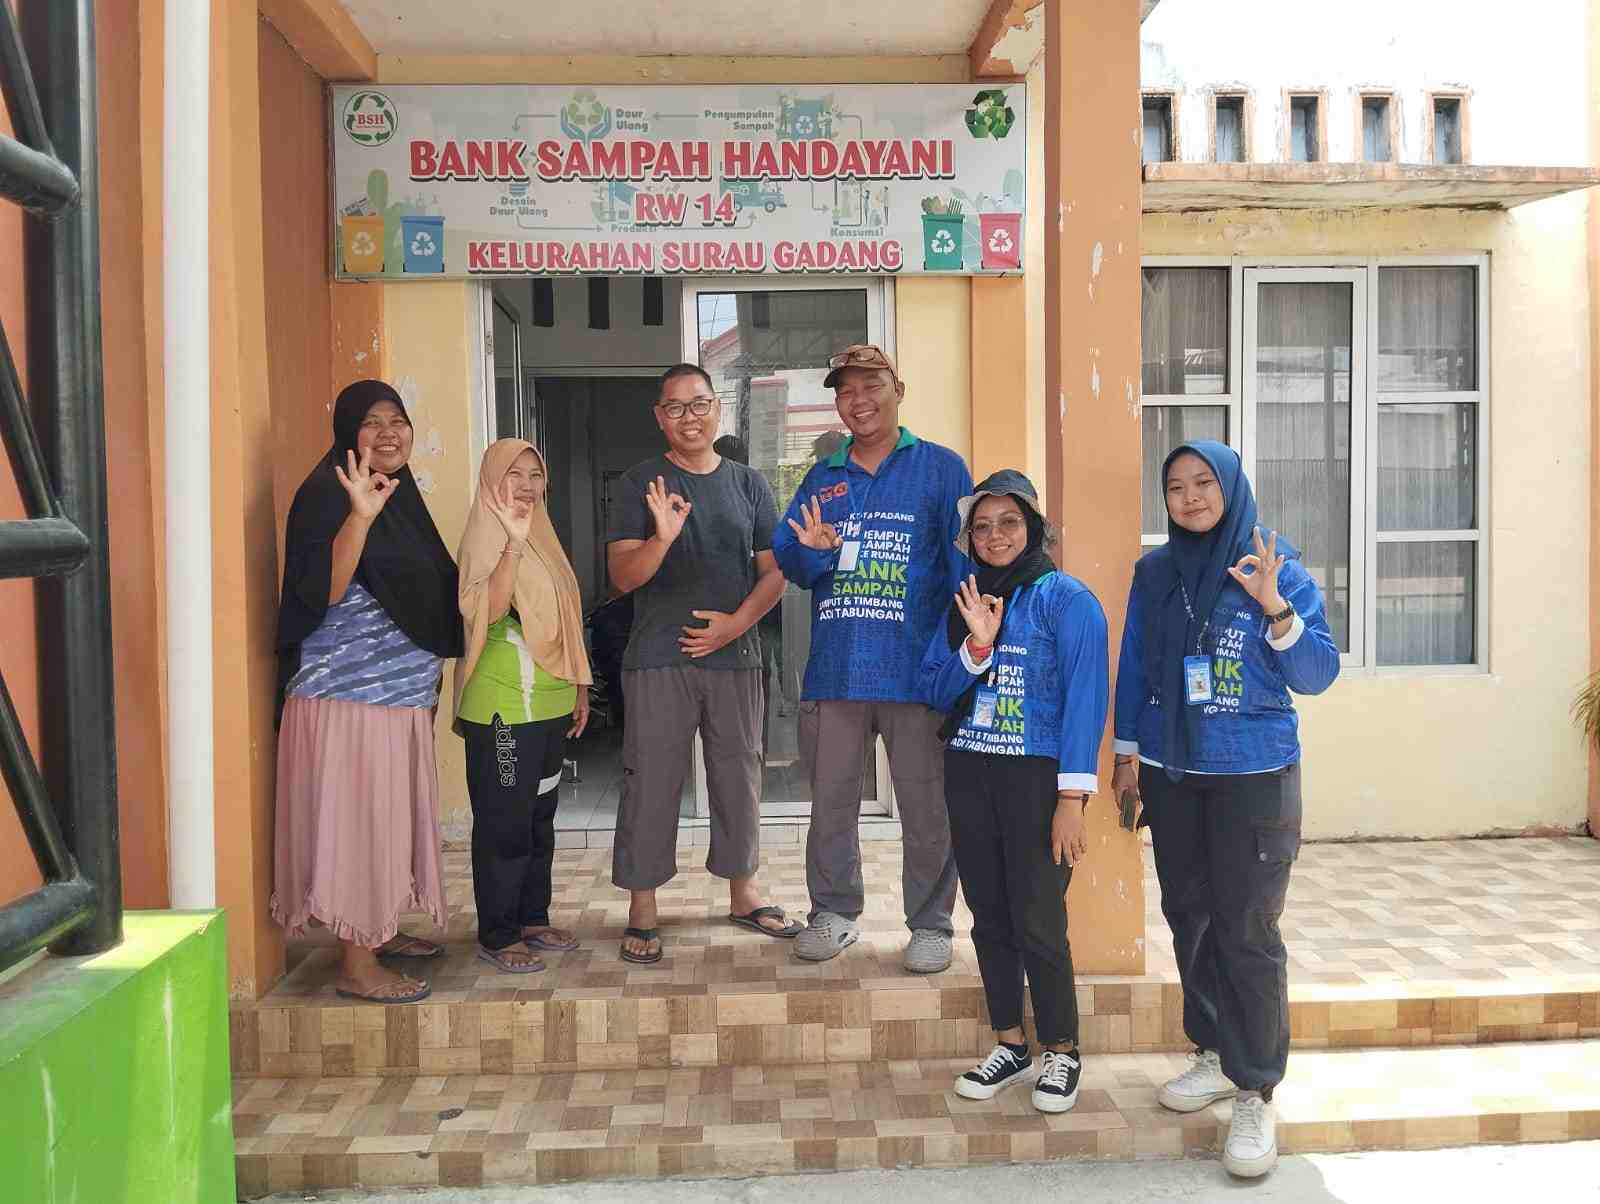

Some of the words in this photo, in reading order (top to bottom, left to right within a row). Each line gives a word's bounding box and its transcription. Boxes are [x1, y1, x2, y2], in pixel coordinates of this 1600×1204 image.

[357, 114, 385, 125] BSH
[704, 110, 774, 121] Pengumpulan
[616, 120, 649, 132] Ulang
[733, 121, 774, 132] Sampah
[409, 140, 529, 181] BANK
[537, 140, 712, 181] SAMPAH
[723, 139, 955, 180] HANDAYANI
[518, 207, 548, 217] Ulang
[635, 192, 688, 226] RW
[695, 192, 737, 226] 14
[467, 241, 655, 274] KELURAHAN
[661, 241, 765, 274] SURAU
[774, 240, 903, 272] GADANG
[874, 511, 915, 522] PADANG
[871, 551, 909, 563] RUMAH
[835, 560, 907, 583] ANK
[833, 582, 906, 599] SAMPAH
[843, 596, 851, 605] &
[853, 597, 903, 610] TIMBANG
[835, 607, 904, 622] TABUNGAN
[965, 740, 1024, 755] TABUNGAN
